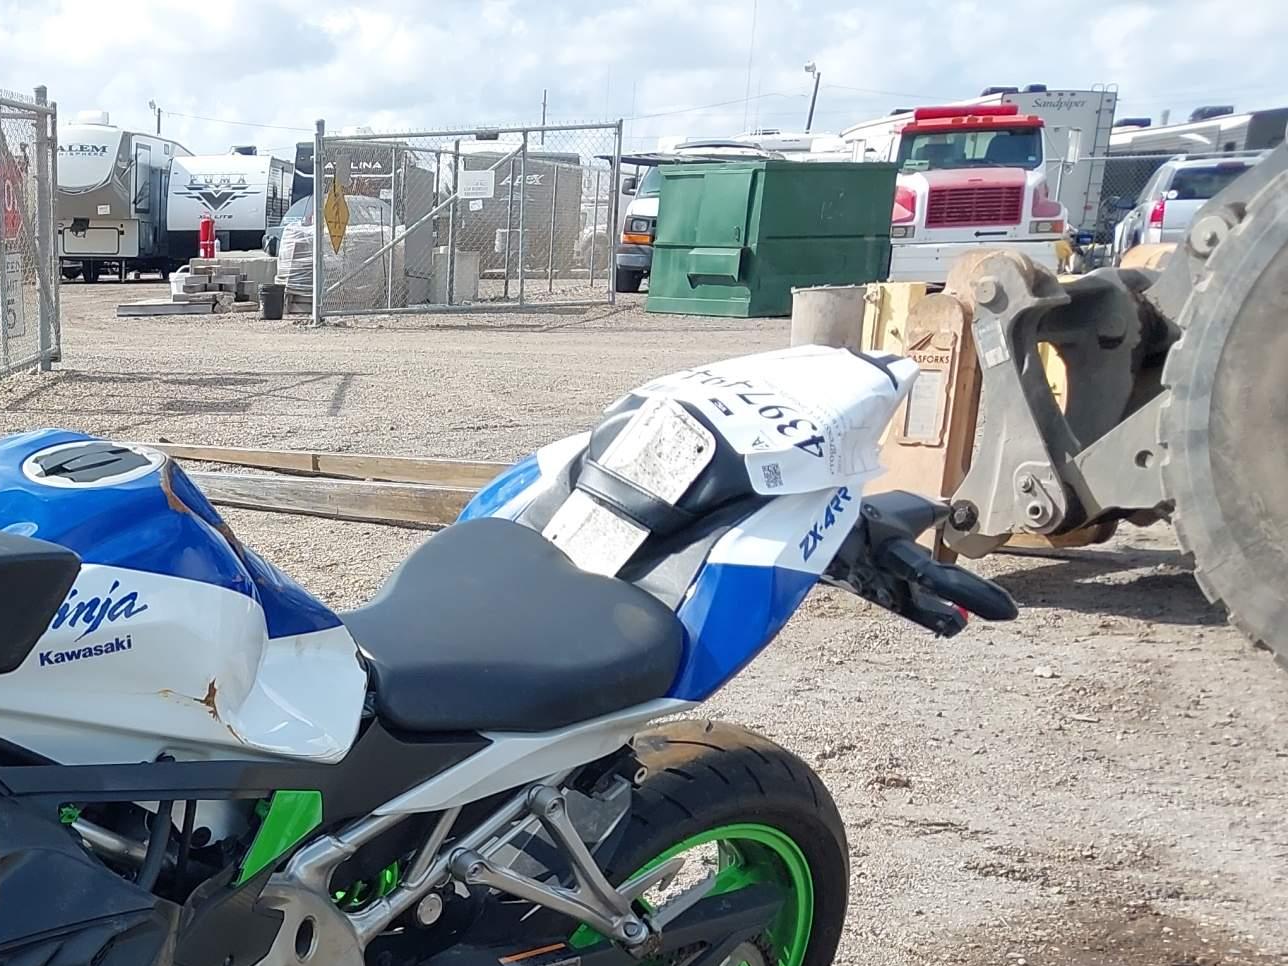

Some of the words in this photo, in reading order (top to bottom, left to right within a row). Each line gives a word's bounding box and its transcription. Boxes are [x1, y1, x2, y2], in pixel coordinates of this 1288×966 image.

[57, 144, 108, 152] ALEM
[190, 174, 247, 184] PUMA
[799, 486, 852, 563] ZX-4RR
[52, 580, 148, 642] inja
[39, 634, 132, 667] Kawasaki
